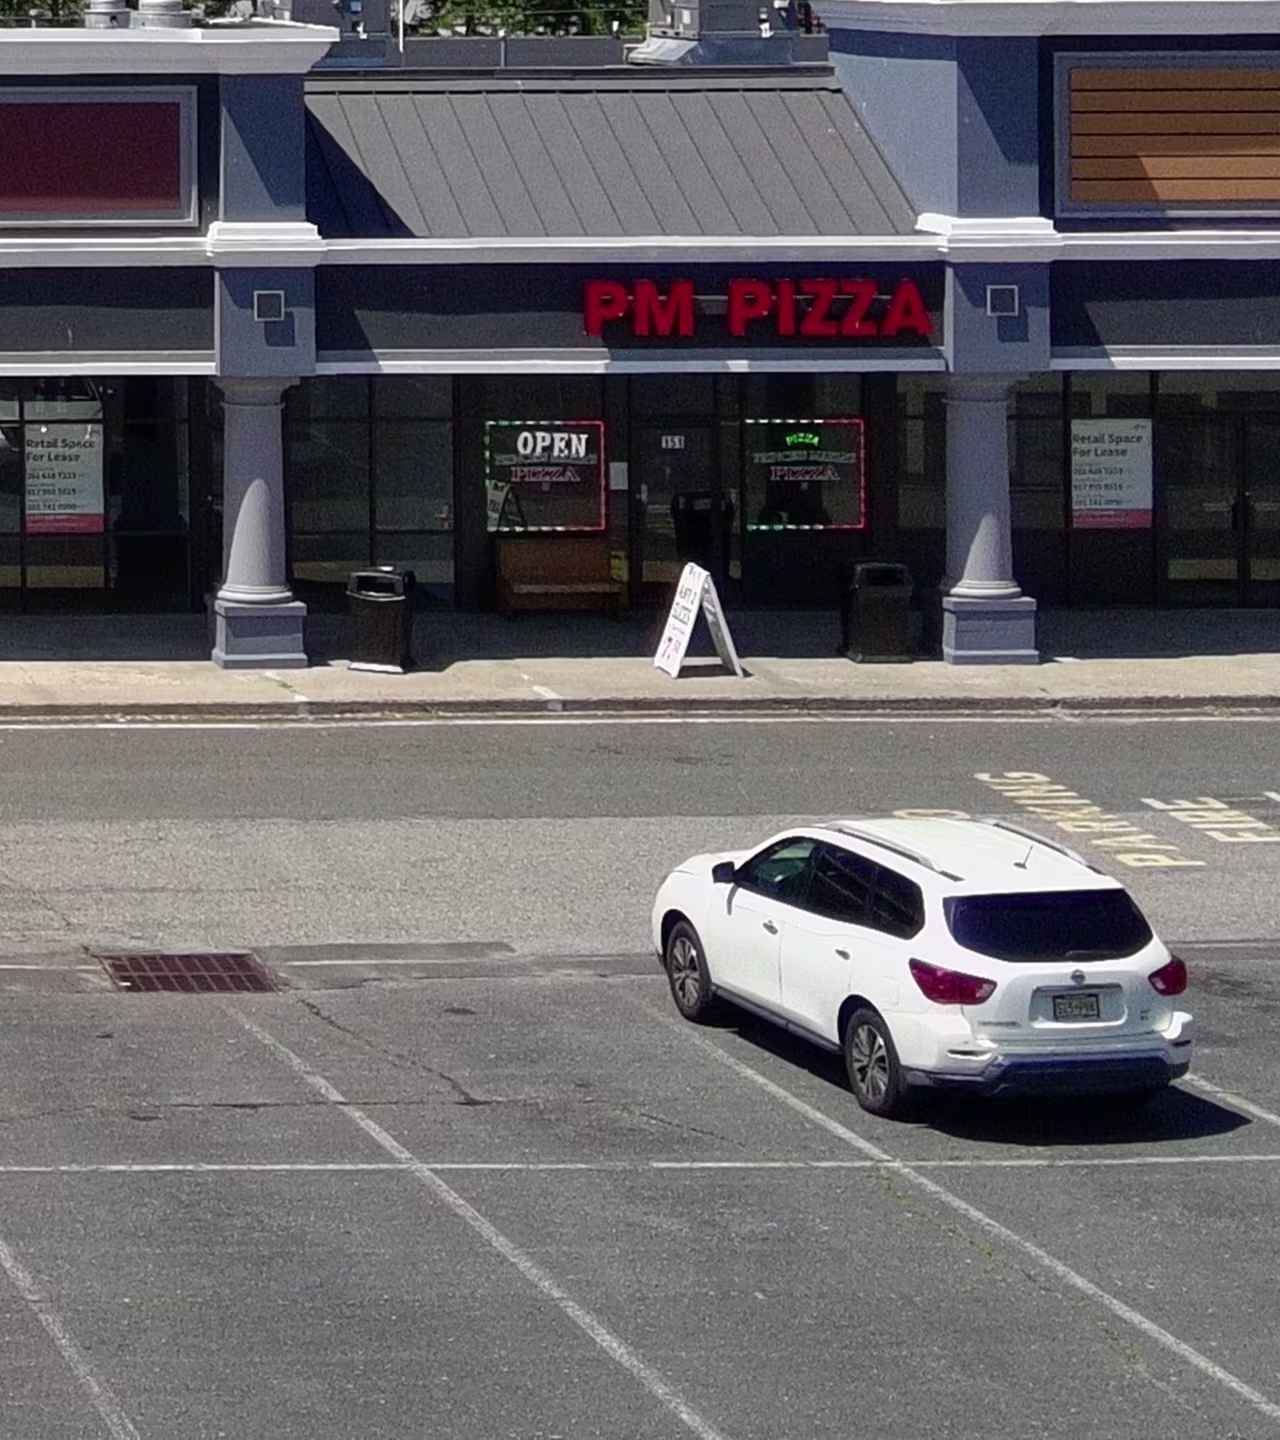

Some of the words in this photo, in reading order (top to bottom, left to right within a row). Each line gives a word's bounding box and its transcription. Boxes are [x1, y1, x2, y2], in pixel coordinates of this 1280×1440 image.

[583, 279, 694, 337] PM
[728, 278, 934, 337] PIZZA
[26, 438, 58, 449] Retail
[60, 439, 95, 450] Space
[517, 432, 589, 458] OPEN
[1108, 434, 1143, 445] Space
[26, 452, 45, 462] For
[47, 452, 81, 462] Lease
[1094, 448, 1128, 457] Lease
[510, 466, 581, 482] PIZZA
[769, 465, 841, 481] PIZZA
[972, 771, 1207, 867] PARKING
[1139, 796, 1280, 842] FIRE
